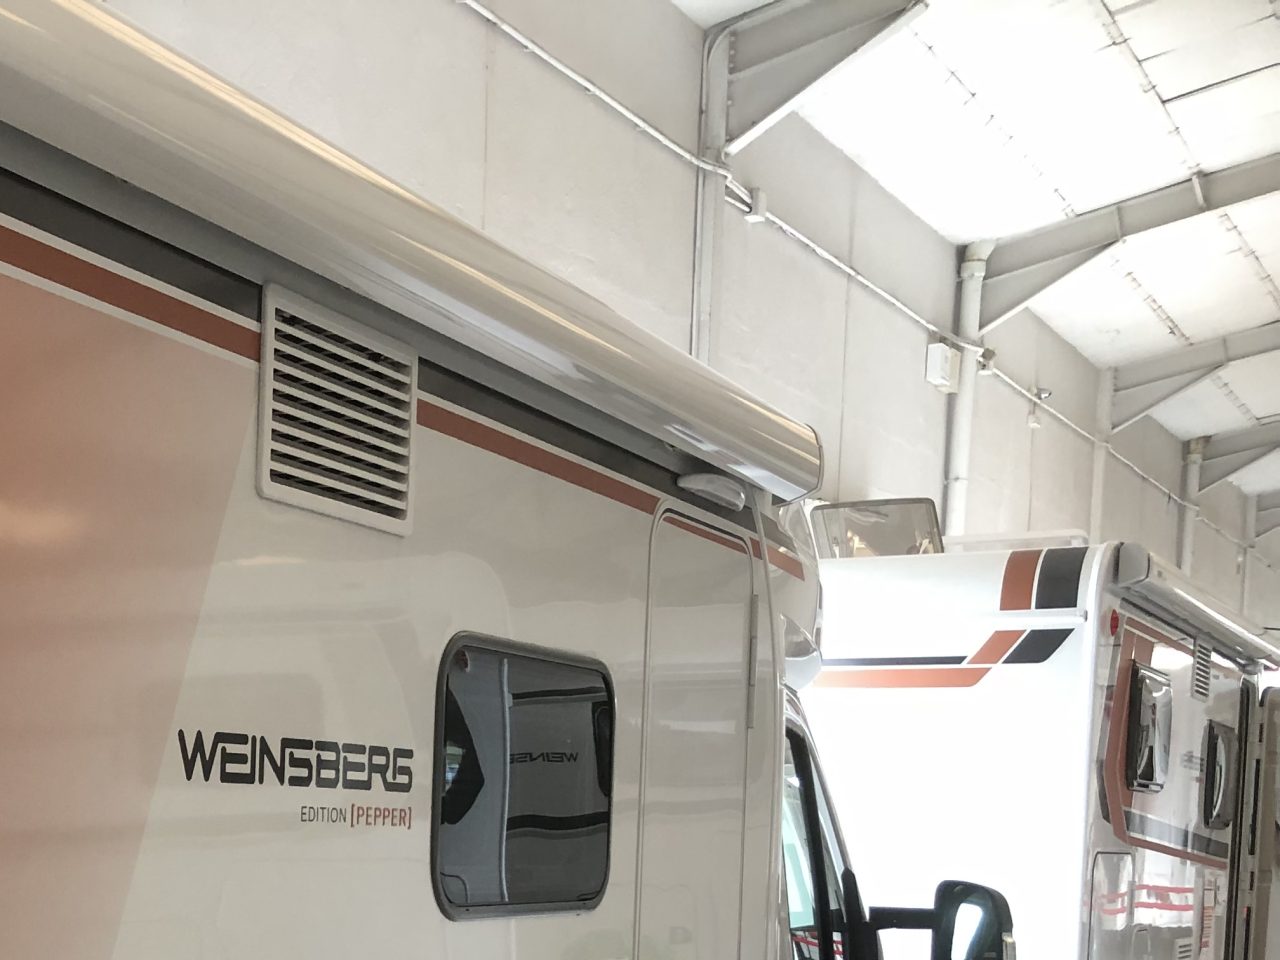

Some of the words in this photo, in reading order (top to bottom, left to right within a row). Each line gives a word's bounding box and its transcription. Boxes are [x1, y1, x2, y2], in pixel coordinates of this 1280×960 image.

[178, 729, 414, 793] WEINSBERG
[300, 805, 347, 824] EDITION
[350, 803, 413, 831] [PEPPER]
